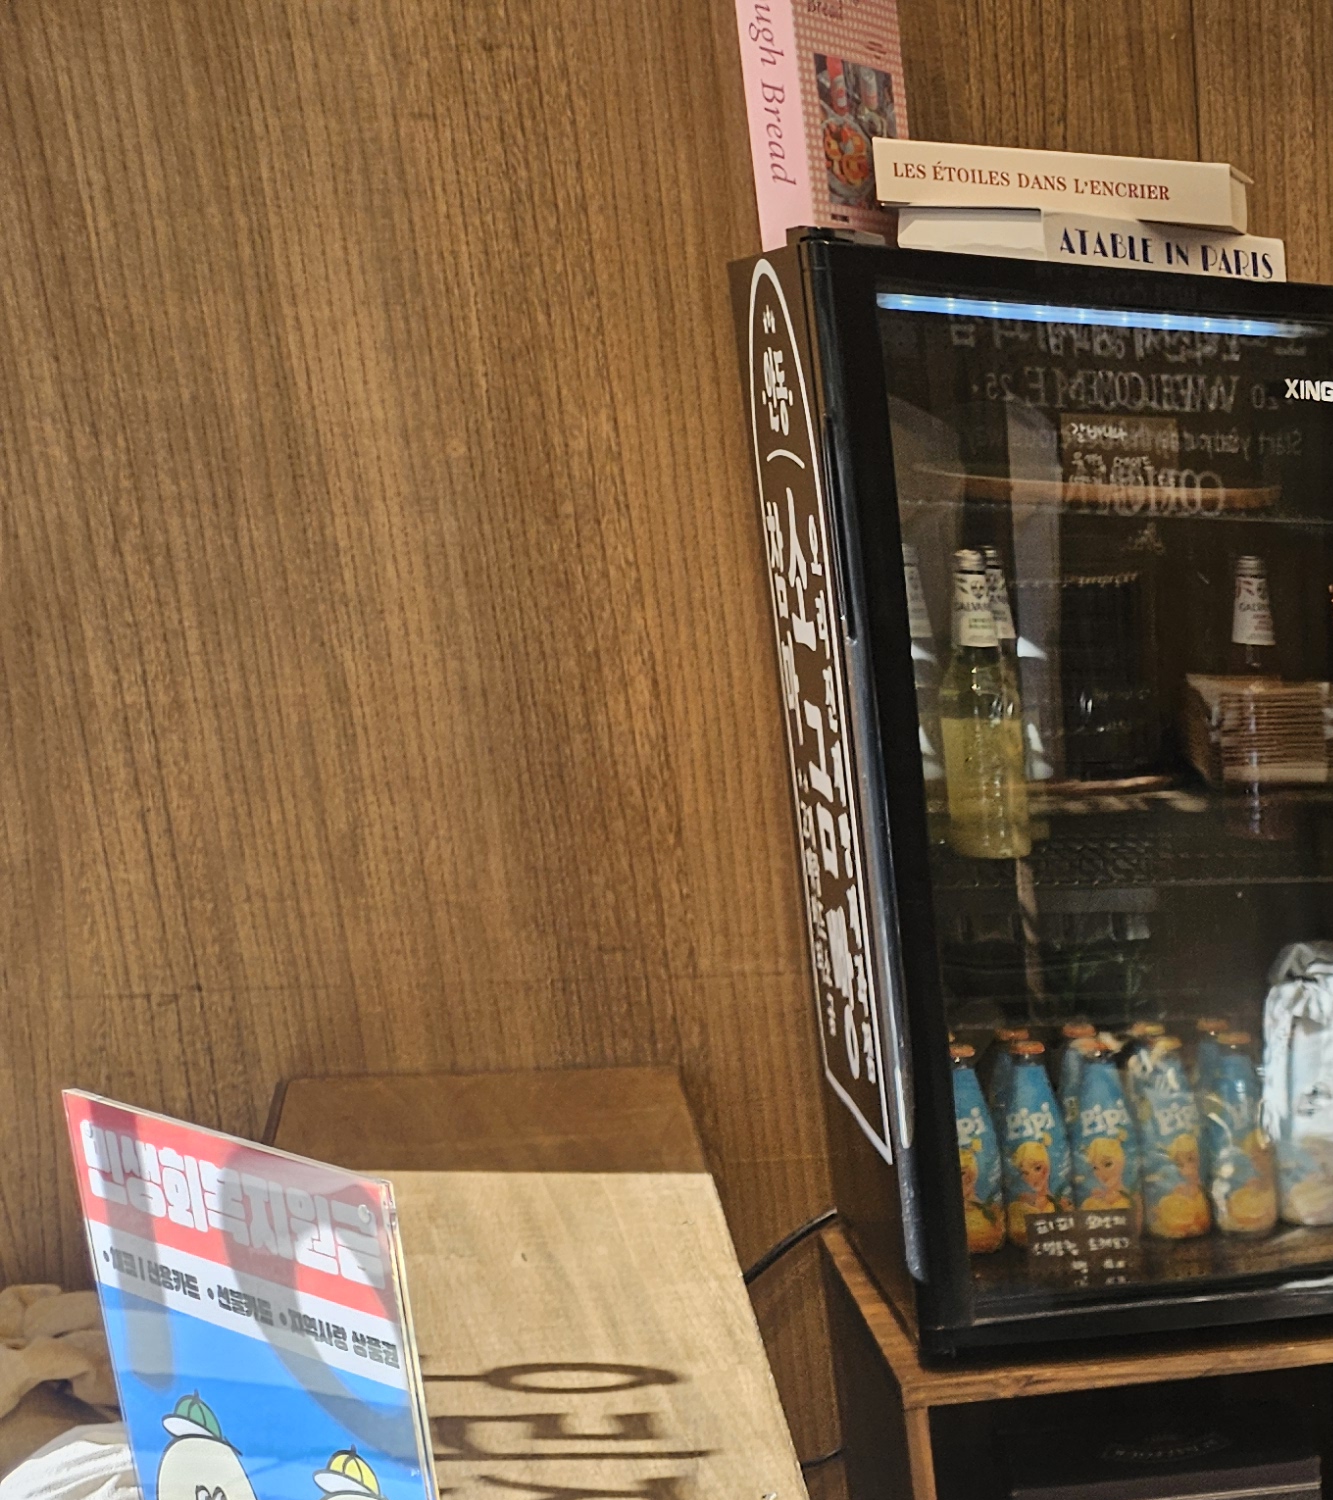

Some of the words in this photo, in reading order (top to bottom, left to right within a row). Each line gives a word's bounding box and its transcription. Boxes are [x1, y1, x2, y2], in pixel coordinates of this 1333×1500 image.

[760, 78, 797, 186] Bread
[892, 161, 927, 183] LES
[931, 161, 1011, 188] ÉTOILES
[1017, 170, 1067, 193] DANS
[1073, 178, 1171, 202] L'ENCRIER
[1201, 243, 1274, 281] PARIS
[79, 1119, 387, 1290] 민생회복지원금
